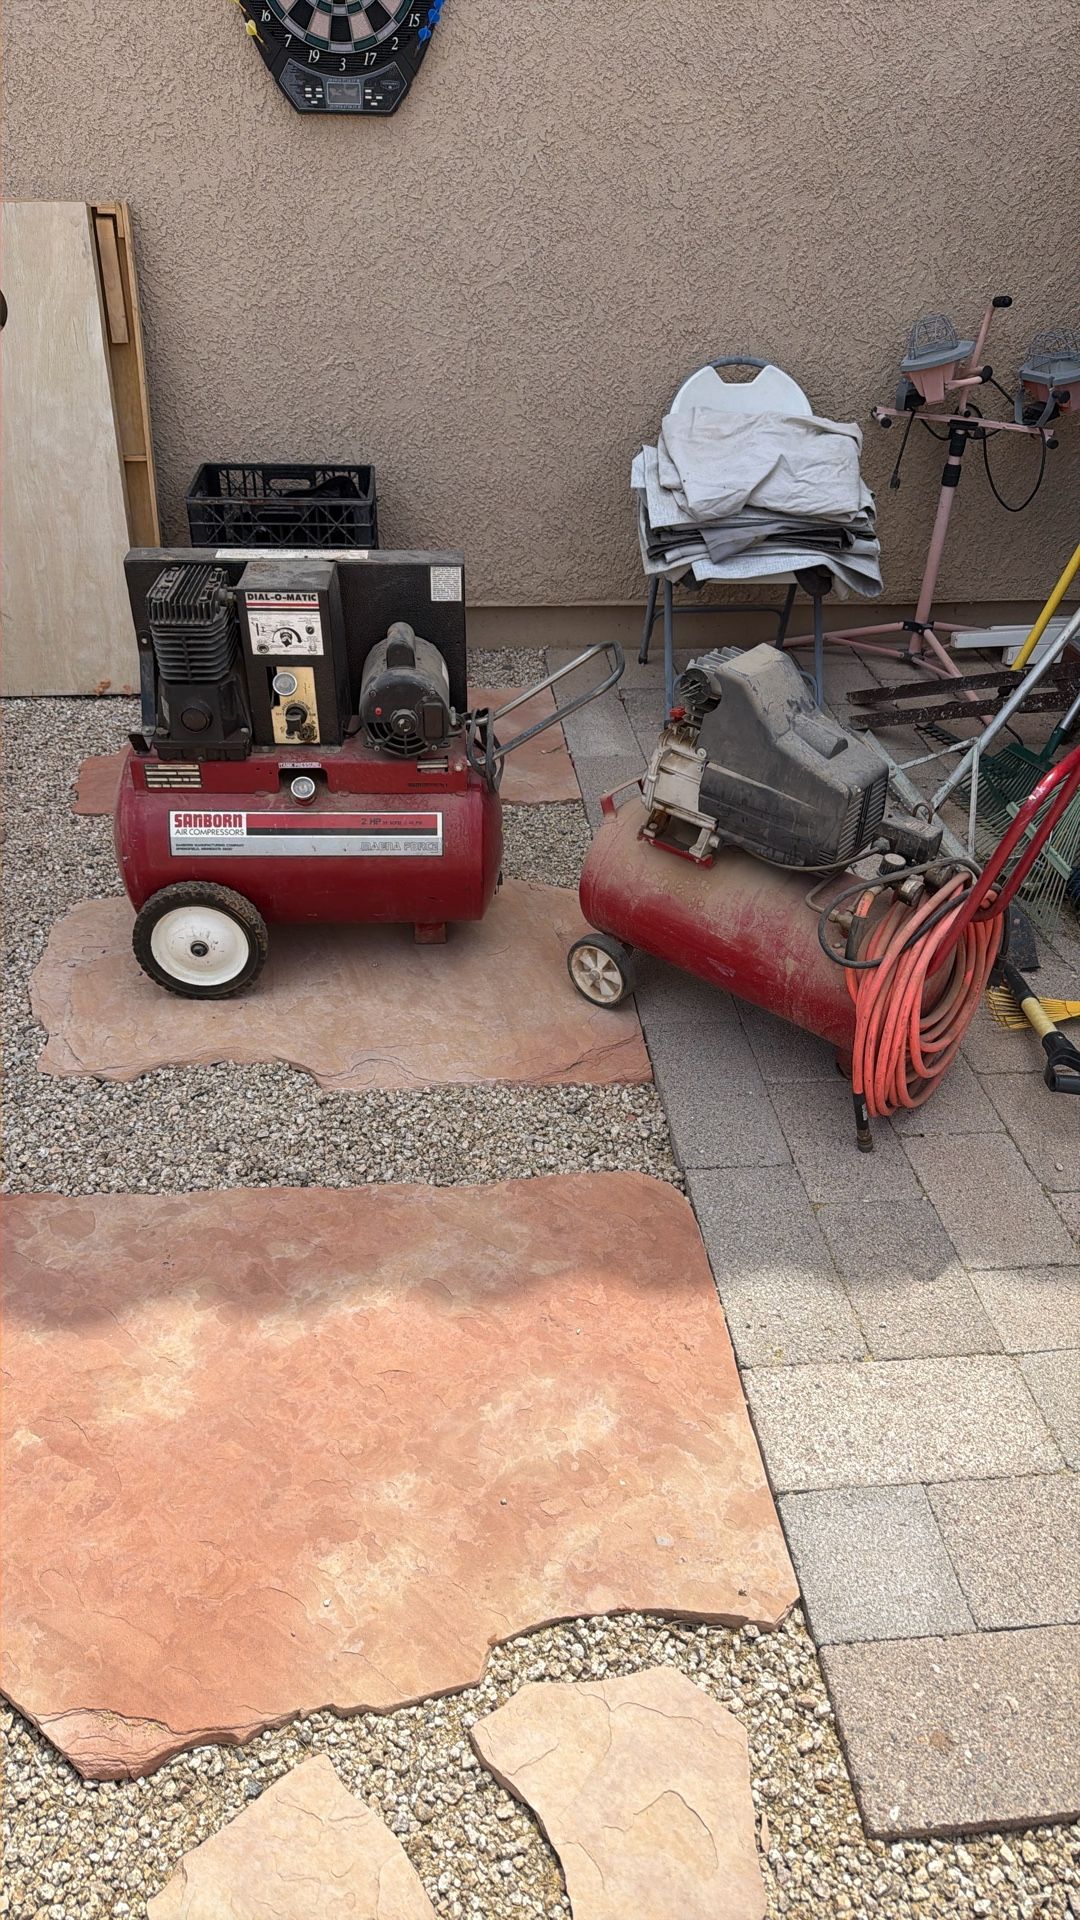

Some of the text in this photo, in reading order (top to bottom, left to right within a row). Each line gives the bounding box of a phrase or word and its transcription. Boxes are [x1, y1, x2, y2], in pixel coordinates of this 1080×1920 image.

[261, 9, 271, 22] 16
[408, 13, 420, 27] 15
[284, 34, 293, 48] 7
[391, 36, 399, 50] 2
[307, 50, 320, 63] 19
[363, 52, 377, 66] 17
[339, 57, 346, 71] 3
[247, 593, 317, 602] DIAL-O-MATIC
[174, 813, 243, 828] SANBORN
[361, 817, 367, 826] 2
[369, 817, 382, 826] HP
[175, 828, 245, 836] AIR COMPRESSORS
[404, 841, 439, 853] FORCE
